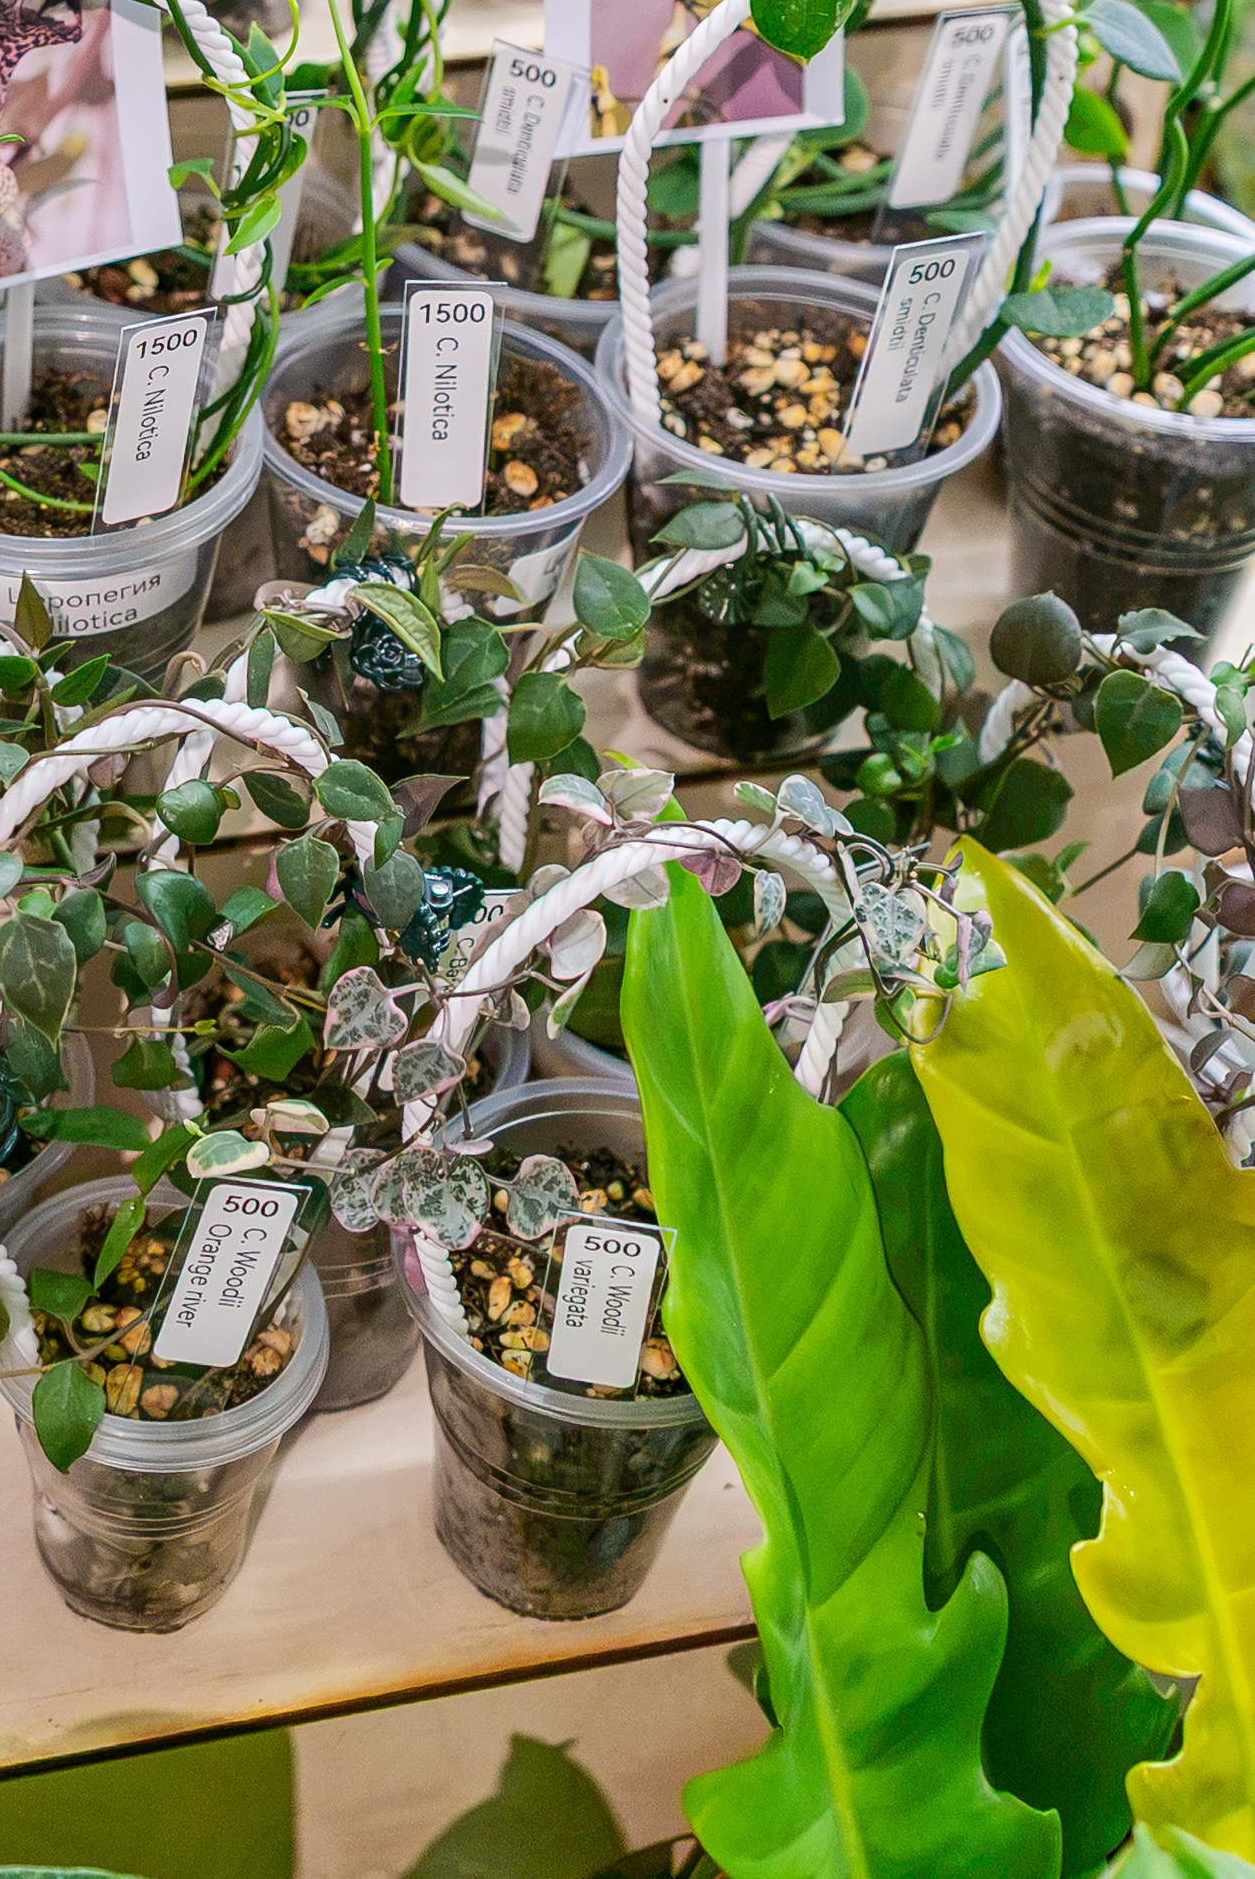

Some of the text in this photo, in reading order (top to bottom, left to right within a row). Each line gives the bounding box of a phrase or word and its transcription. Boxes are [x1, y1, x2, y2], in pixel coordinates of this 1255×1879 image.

[509, 58, 557, 88] 500
[506, 111, 542, 195] Denticulata
[908, 258, 956, 285] 500
[419, 303, 486, 324] 1500
[136, 329, 198, 359] 1500
[895, 292, 941, 403] C. Denticulata
[135, 365, 170, 462] C. Nilotica
[431, 337, 459, 441] C. Nilotica
[8, 574, 161, 613] Цропегия
[51, 608, 137, 633] ilotica
[223, 1195, 279, 1217] 500
[218, 1227, 267, 1308] C. Woodii
[583, 1235, 641, 1257] 500
[175, 1223, 232, 1328] Orange river
[562, 1259, 596, 1328] variegata
[600, 1265, 636, 1337] C. Woodii
